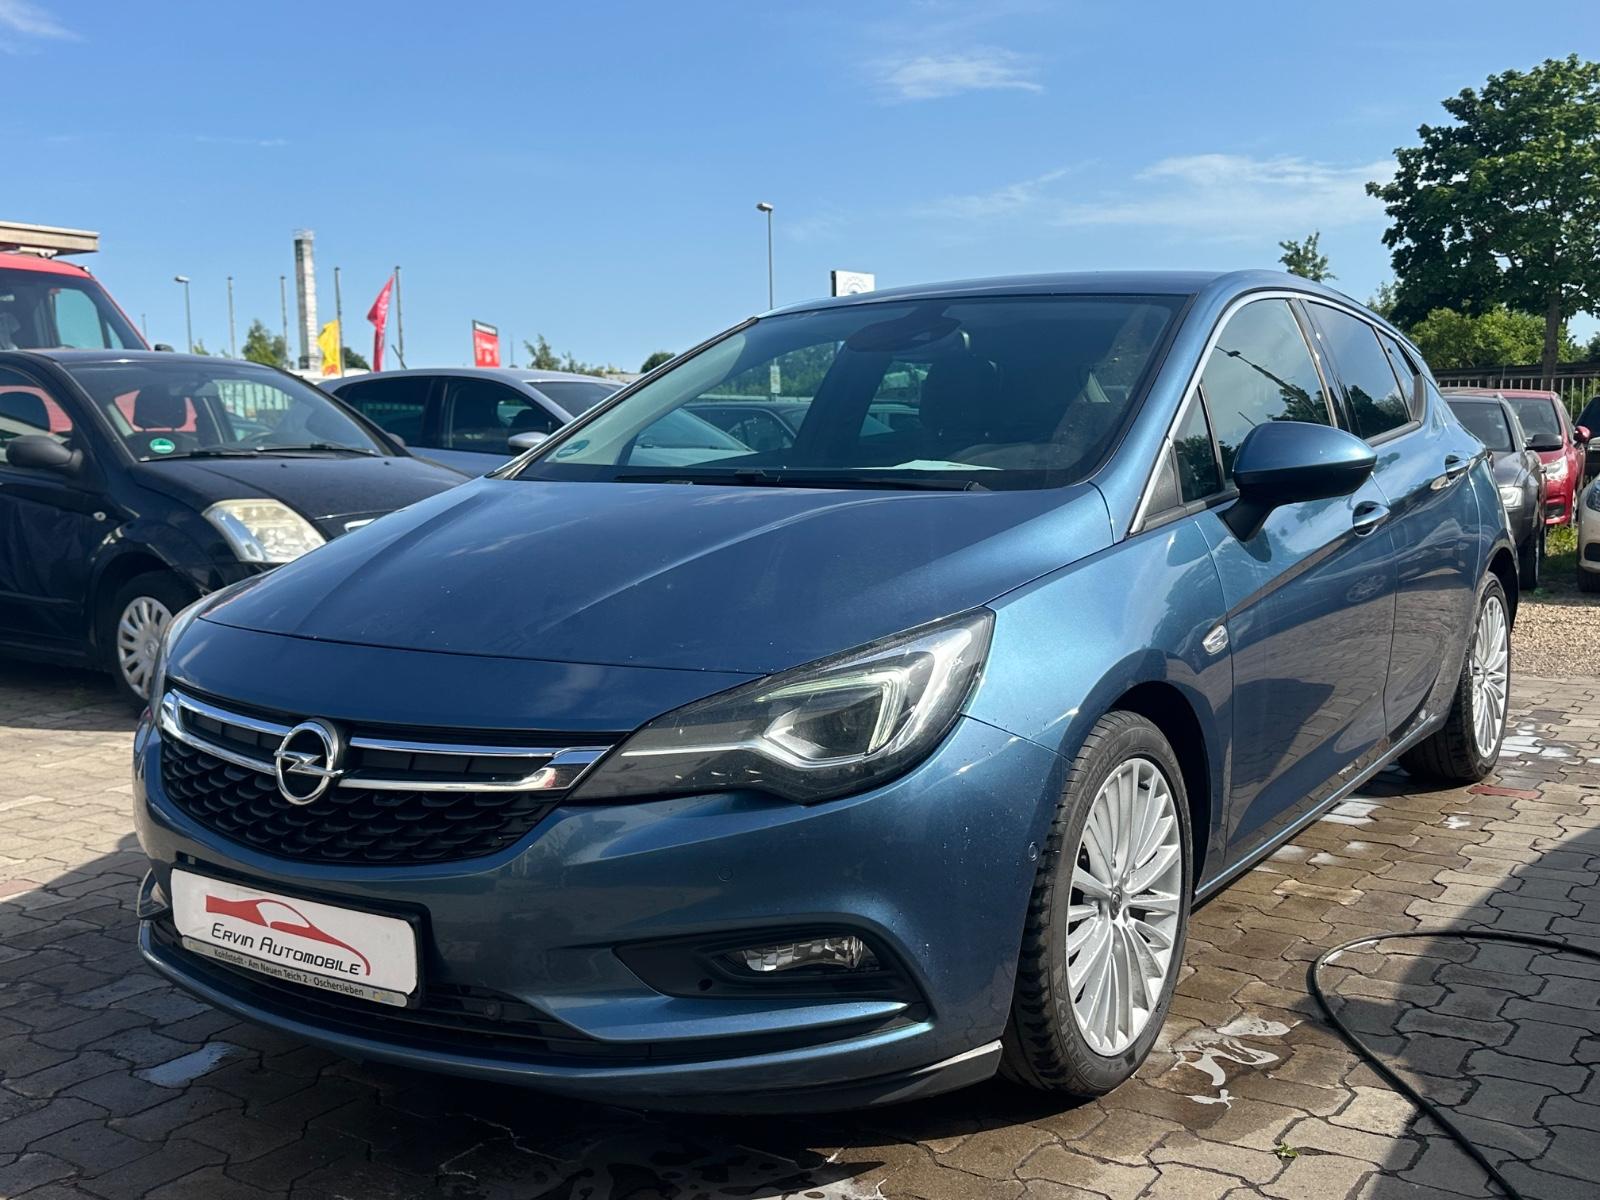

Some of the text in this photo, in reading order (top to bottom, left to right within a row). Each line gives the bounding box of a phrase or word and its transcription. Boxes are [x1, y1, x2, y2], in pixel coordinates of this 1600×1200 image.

[248, 959, 259, 970] Am
[261, 963, 283, 977] Neuen
[283, 970, 302, 982] Teich
[303, 975, 308, 983] 2
[314, 977, 364, 996] Oschersleben
